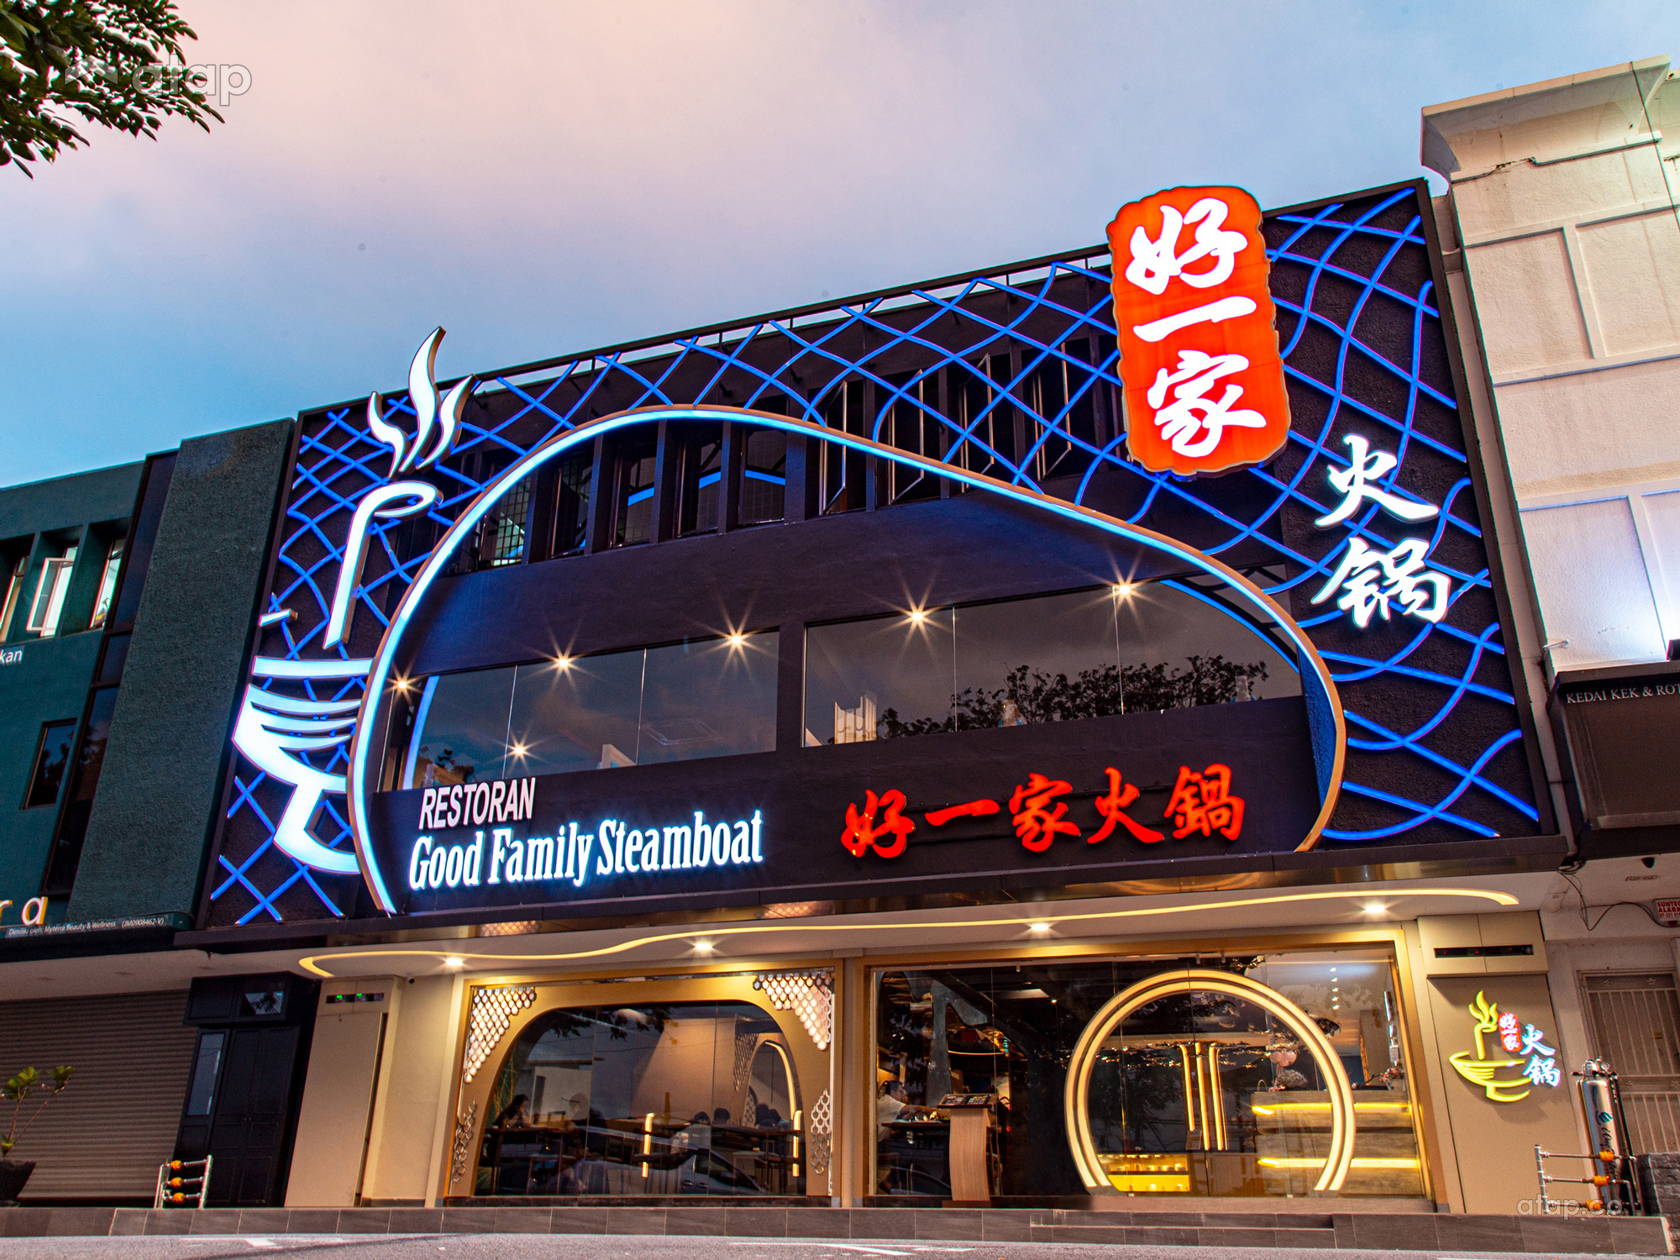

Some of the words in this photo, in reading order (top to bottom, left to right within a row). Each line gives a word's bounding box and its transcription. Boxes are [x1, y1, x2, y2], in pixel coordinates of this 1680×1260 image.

[1125, 197, 1268, 459] 好一家
[1566, 690, 1608, 704] KEDAI
[1610, 687, 1640, 700] KEK
[1642, 686, 1654, 697] &
[418, 777, 536, 830] RESTORAN
[408, 831, 484, 892] Good
[487, 821, 594, 888] Family
[597, 809, 764, 876] Steamboat
